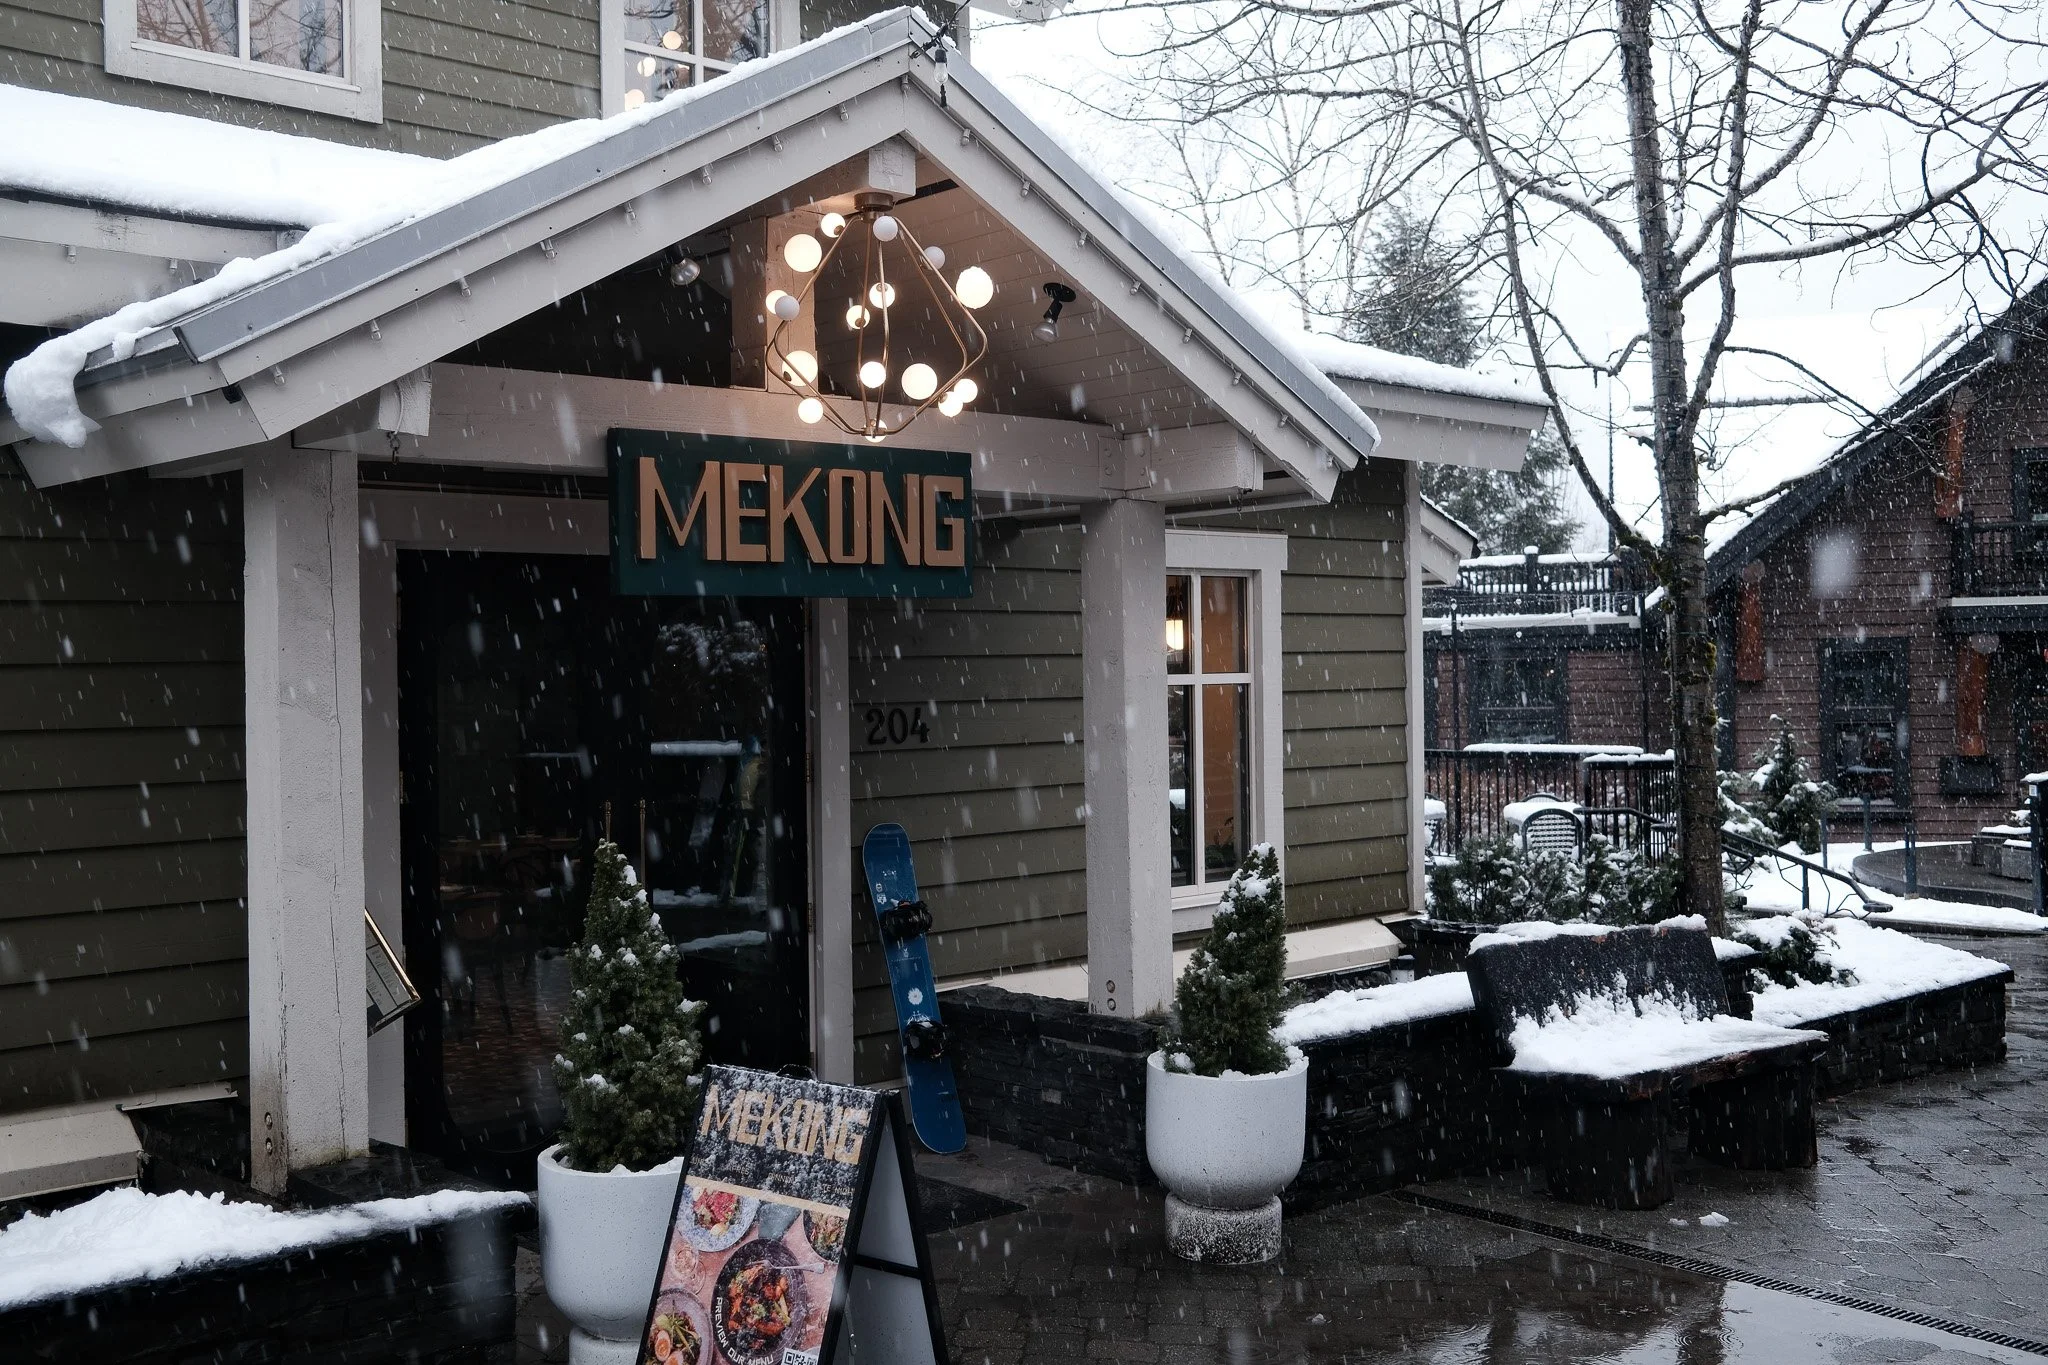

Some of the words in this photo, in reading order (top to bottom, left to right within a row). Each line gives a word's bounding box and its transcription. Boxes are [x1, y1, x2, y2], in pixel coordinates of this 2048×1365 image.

[639, 456, 966, 567] MEKONG
[866, 707, 930, 745] 204
[700, 1084, 871, 1165] MEKONG
[714, 1297, 729, 1347] PREVIEW
[727, 1347, 745, 1365] OUR
[746, 1354, 774, 1365] MENU
